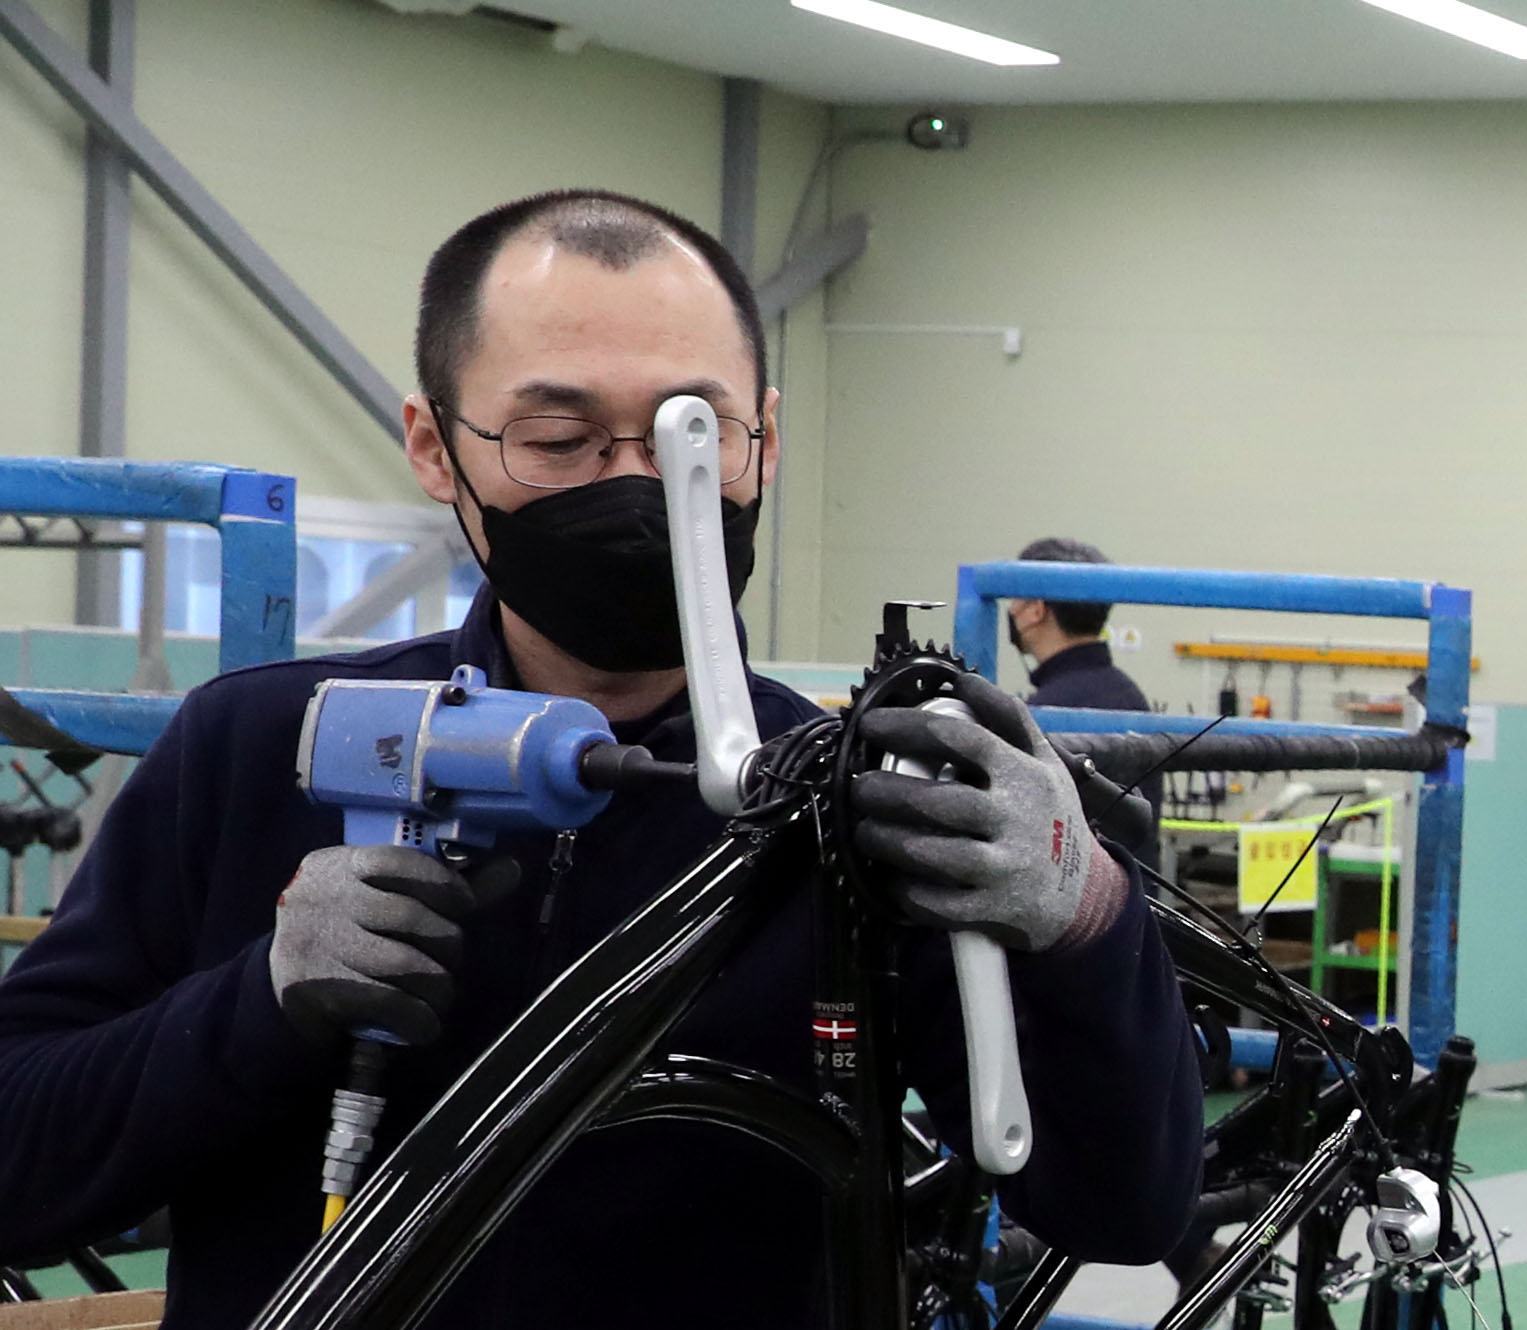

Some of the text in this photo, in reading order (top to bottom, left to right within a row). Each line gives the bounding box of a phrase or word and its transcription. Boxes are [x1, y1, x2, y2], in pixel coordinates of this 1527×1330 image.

[267, 484, 285, 512] 6
[1051, 819, 1064, 865] 3M
[832, 1052, 856, 1067] 28
